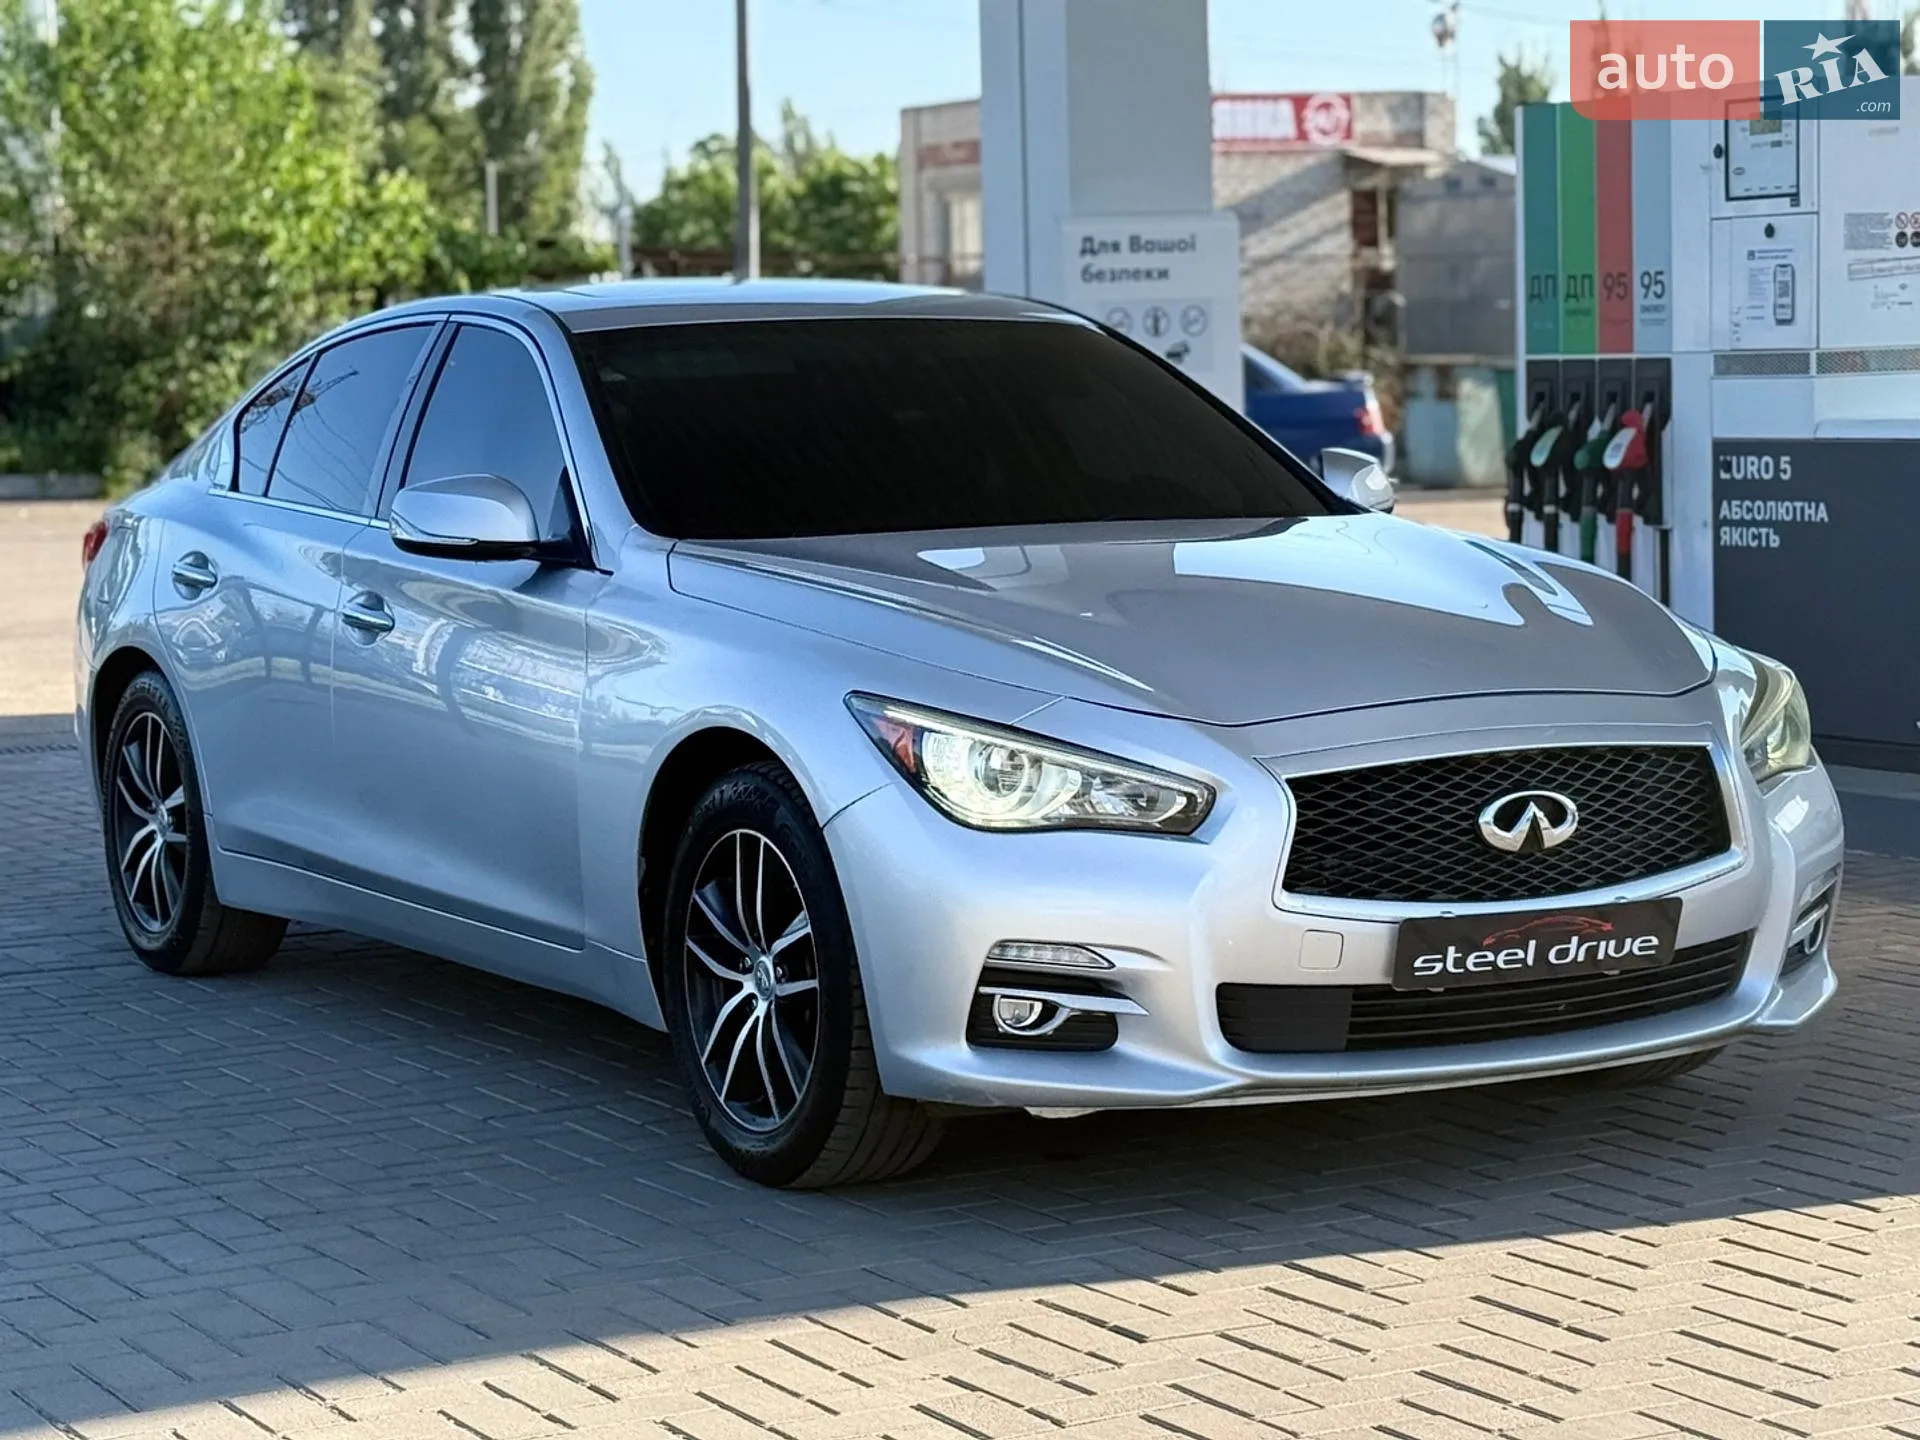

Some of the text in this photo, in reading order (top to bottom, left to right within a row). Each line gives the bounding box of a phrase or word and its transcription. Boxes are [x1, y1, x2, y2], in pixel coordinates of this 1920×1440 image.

[1079, 232, 1197, 257] Для Вашої
[1080, 262, 1170, 284] безпеки
[1602, 271, 1629, 302] 95
[1640, 270, 1667, 300] 95
[1528, 273, 1557, 304] ДП
[1563, 273, 1594, 303] ДП
[1779, 455, 1792, 480] 5
[1719, 499, 1829, 522] АБСОЛЮТНА
[1719, 526, 1781, 548] ЯКІСТЬ
[1413, 934, 1660, 976] steel drive
